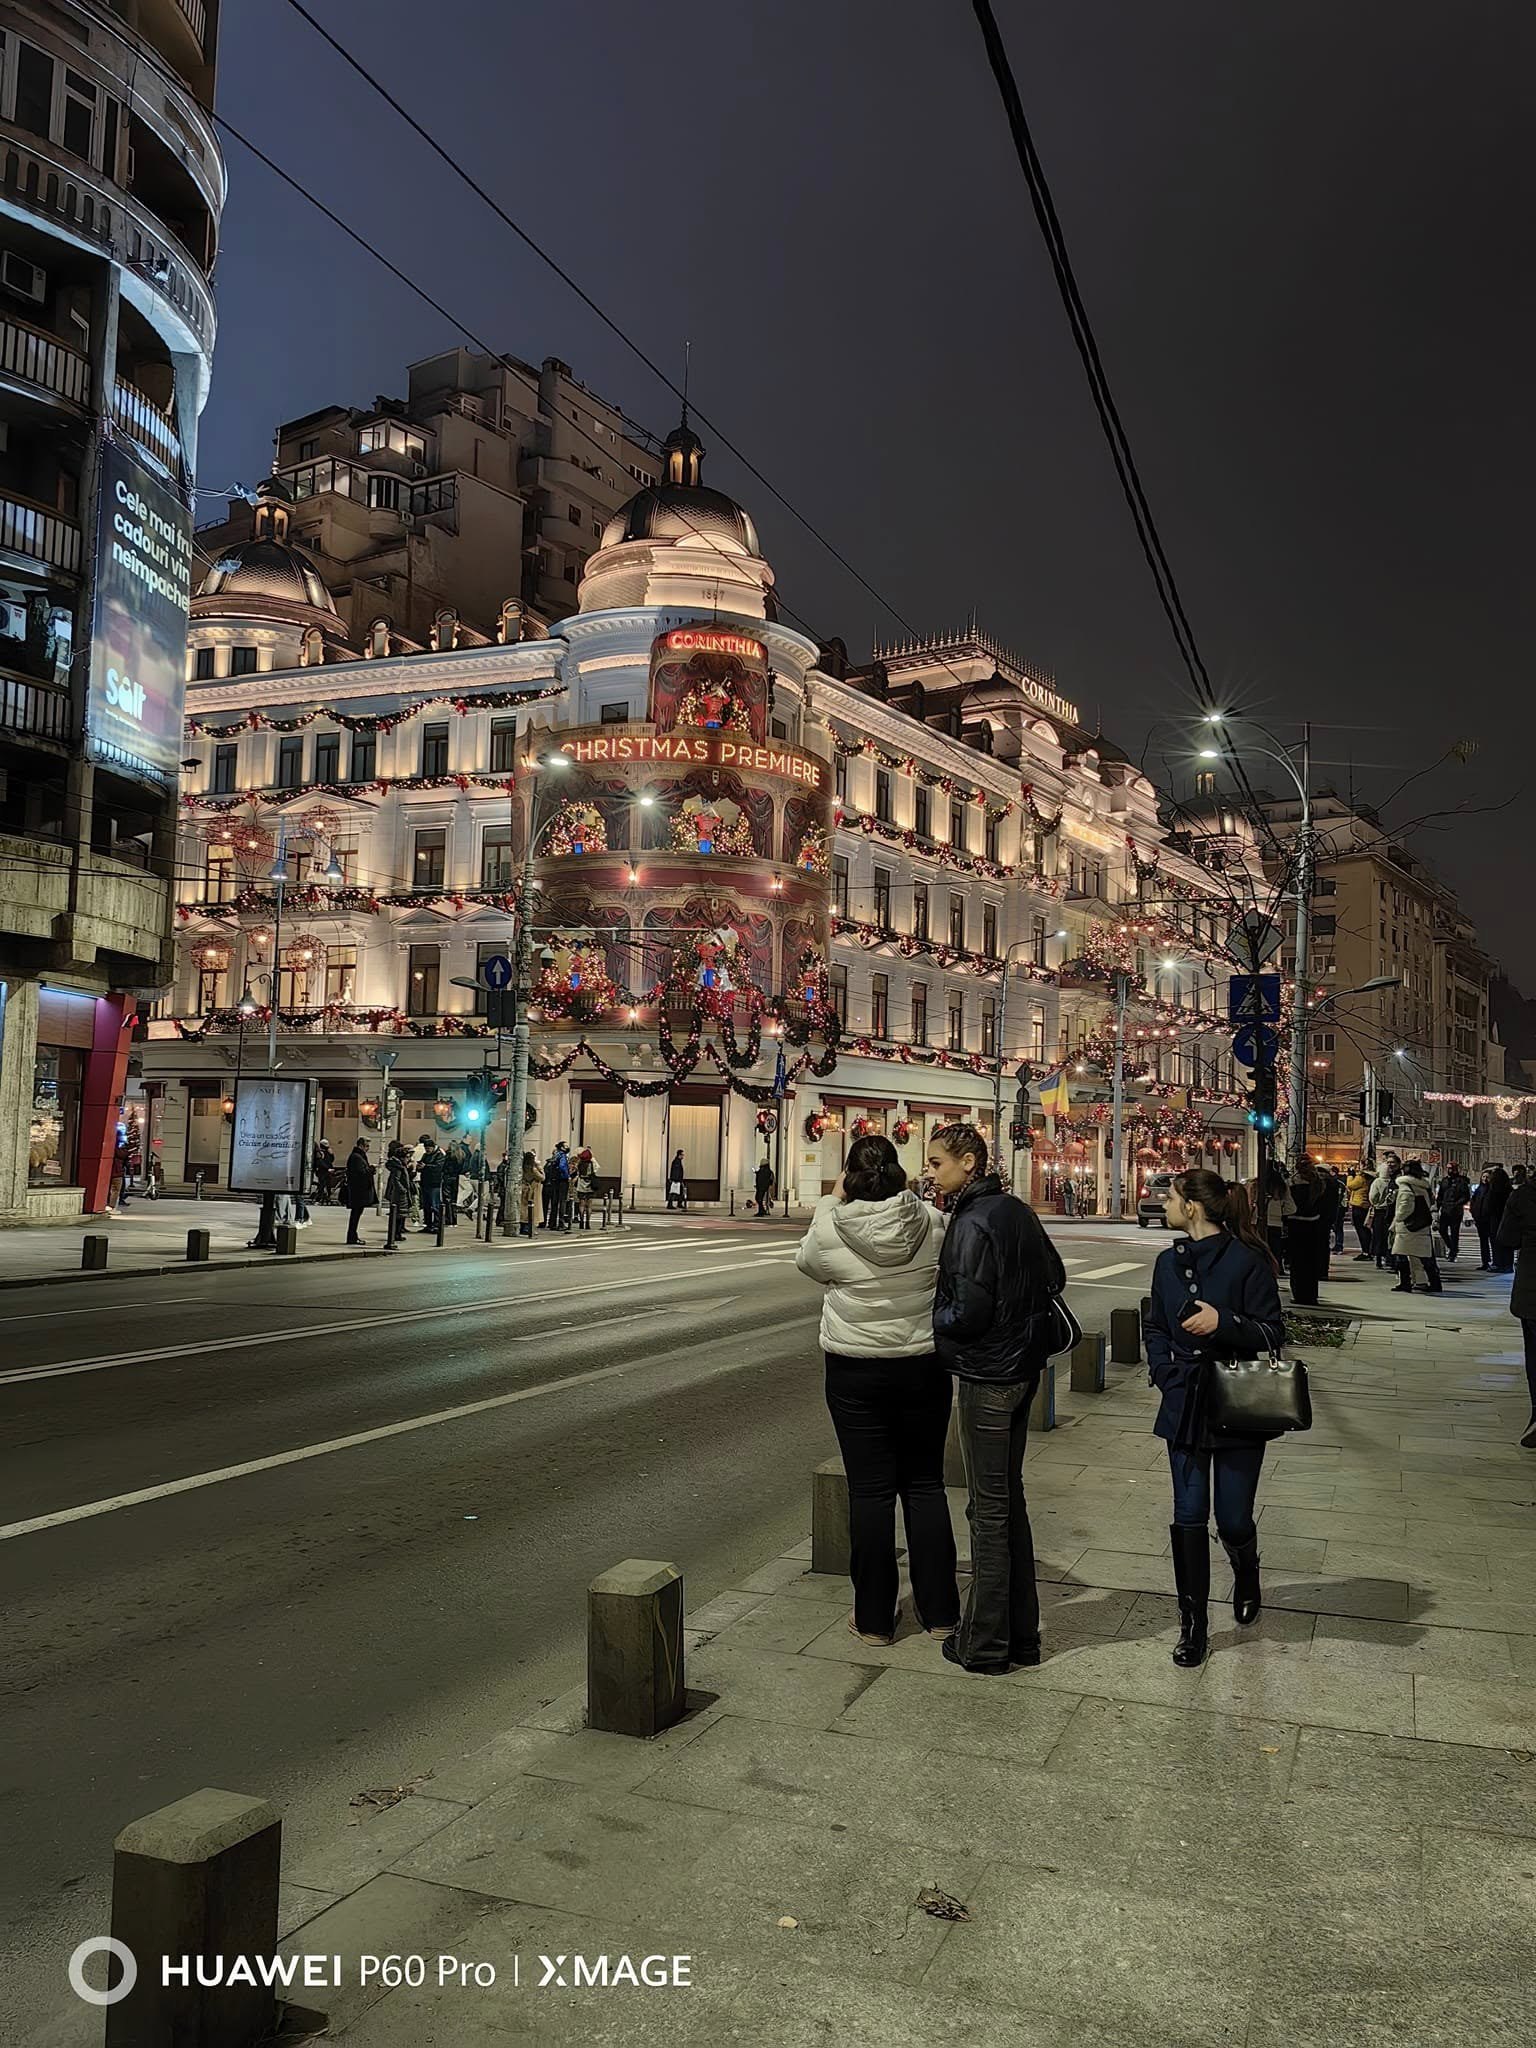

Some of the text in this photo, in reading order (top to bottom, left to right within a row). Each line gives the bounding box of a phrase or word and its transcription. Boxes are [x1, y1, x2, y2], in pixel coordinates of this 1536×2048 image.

[115, 480, 148, 520] Cele
[149, 509, 175, 545] mai
[114, 513, 169, 569] cadouri
[671, 634, 761, 659] CORINTHIA
[1022, 676, 1079, 724] CORINTHIA
[721, 743, 821, 787] PREMIERE
